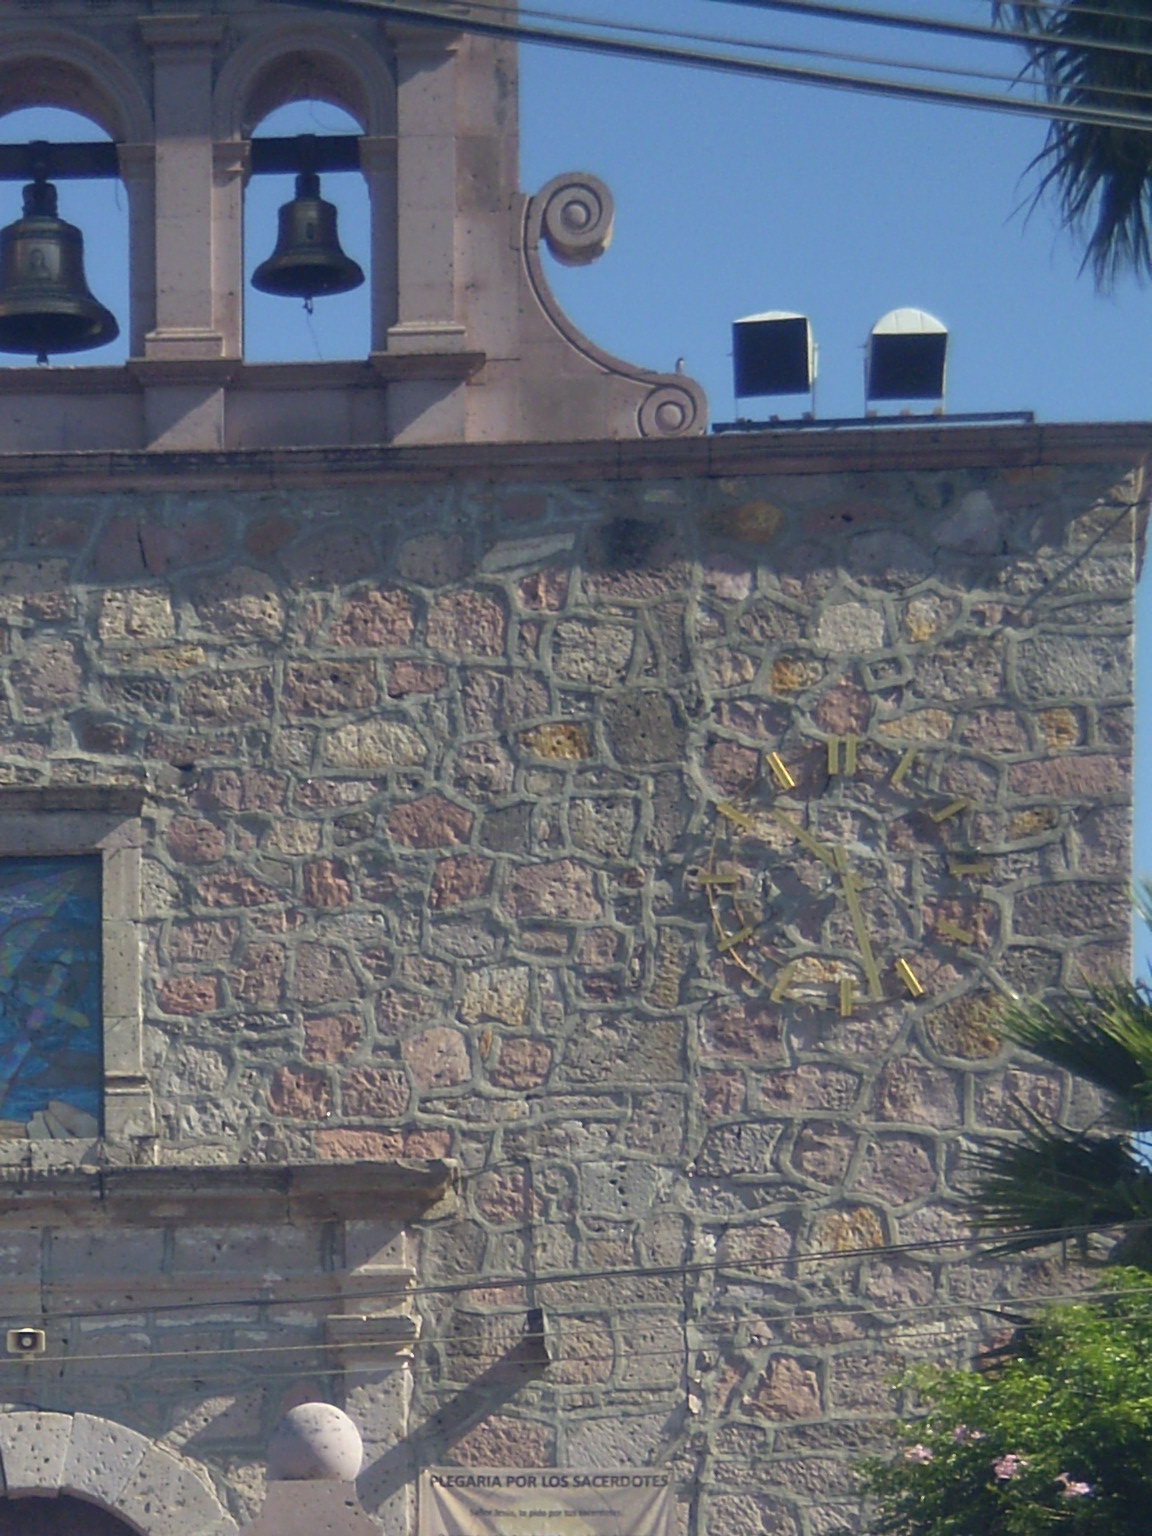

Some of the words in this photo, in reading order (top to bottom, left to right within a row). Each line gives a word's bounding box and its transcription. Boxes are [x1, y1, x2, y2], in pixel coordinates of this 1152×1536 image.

[430, 1475, 502, 1488] PLEGARIA
[506, 1475, 537, 1488] POR
[541, 1475, 568, 1488] LOS
[573, 1475, 668, 1488] SACERDOTES
[548, 1508, 562, 1518] por
